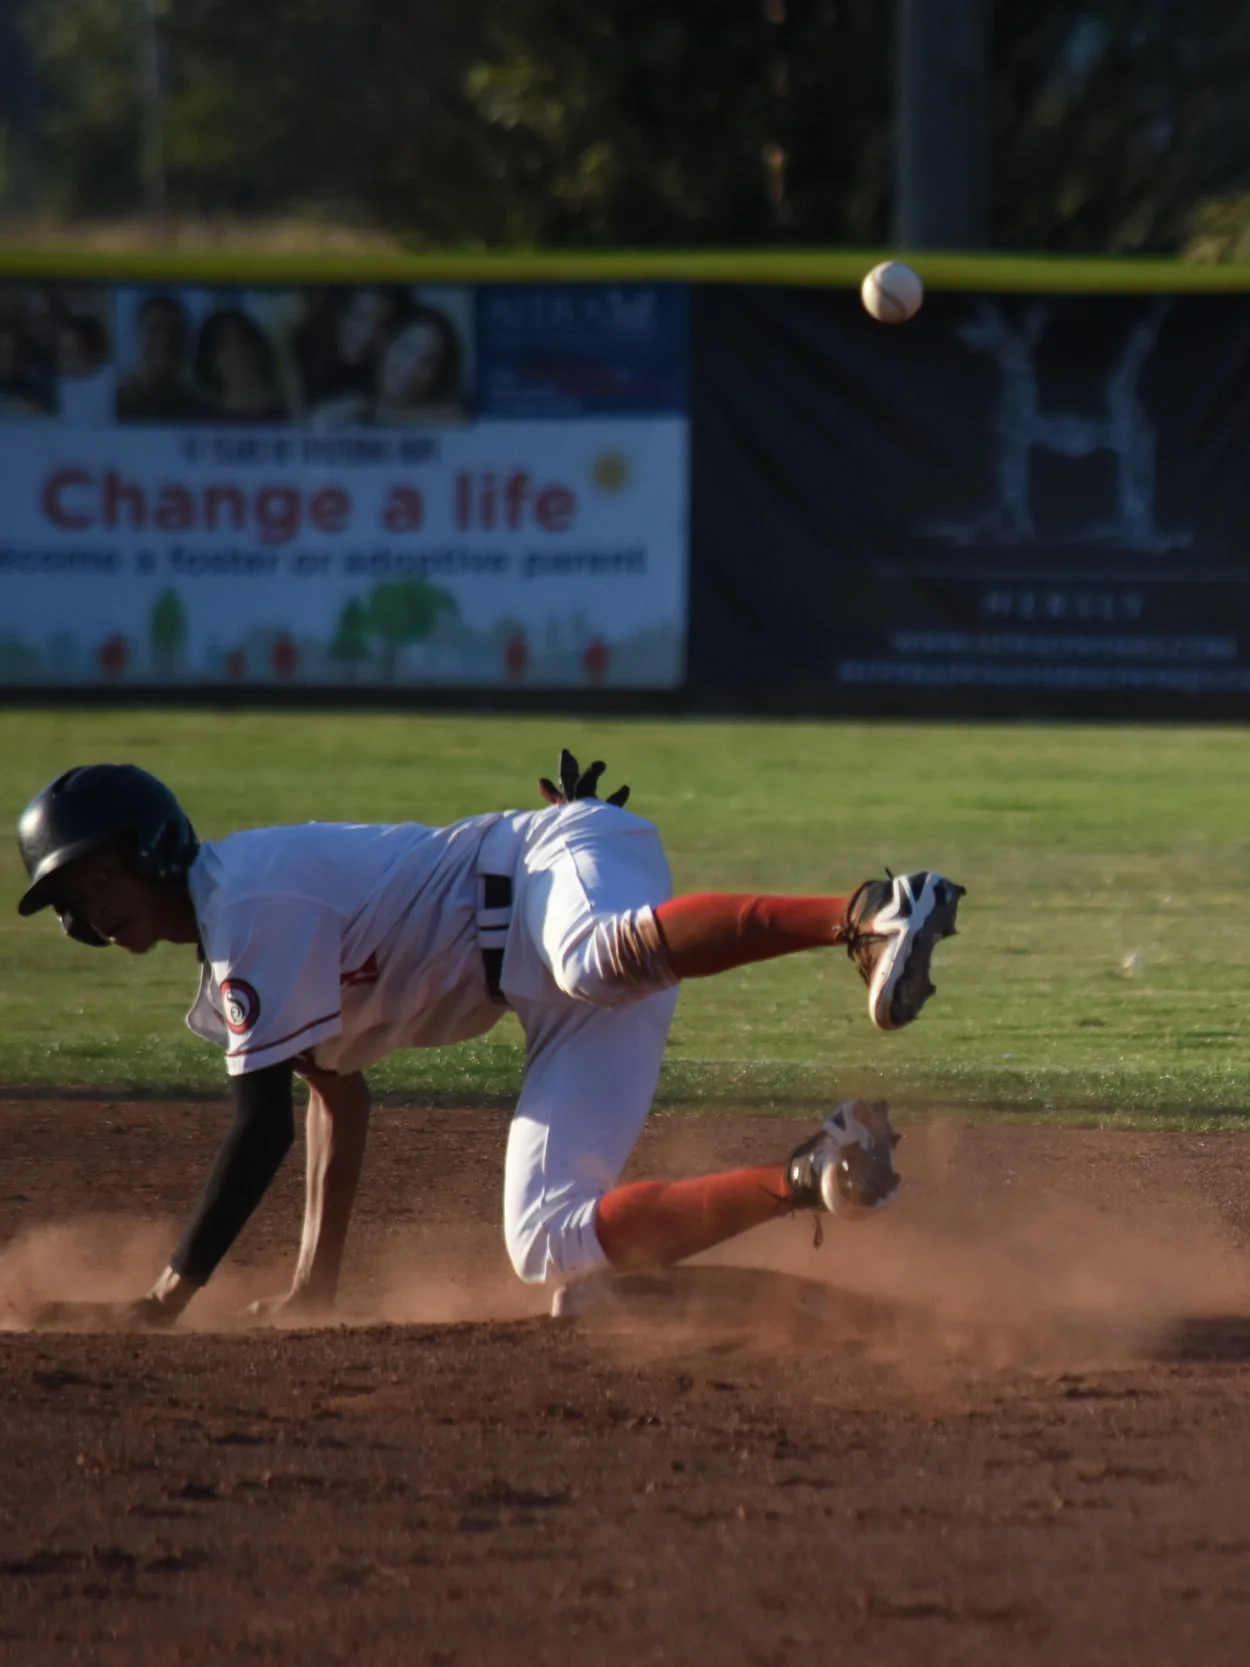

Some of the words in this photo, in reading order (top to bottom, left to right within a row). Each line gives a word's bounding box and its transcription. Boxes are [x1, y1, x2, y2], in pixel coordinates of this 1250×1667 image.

[40, 466, 351, 545] Change
[383, 480, 424, 533] a
[455, 468, 579, 533] life
[170, 545, 280, 577] foster
